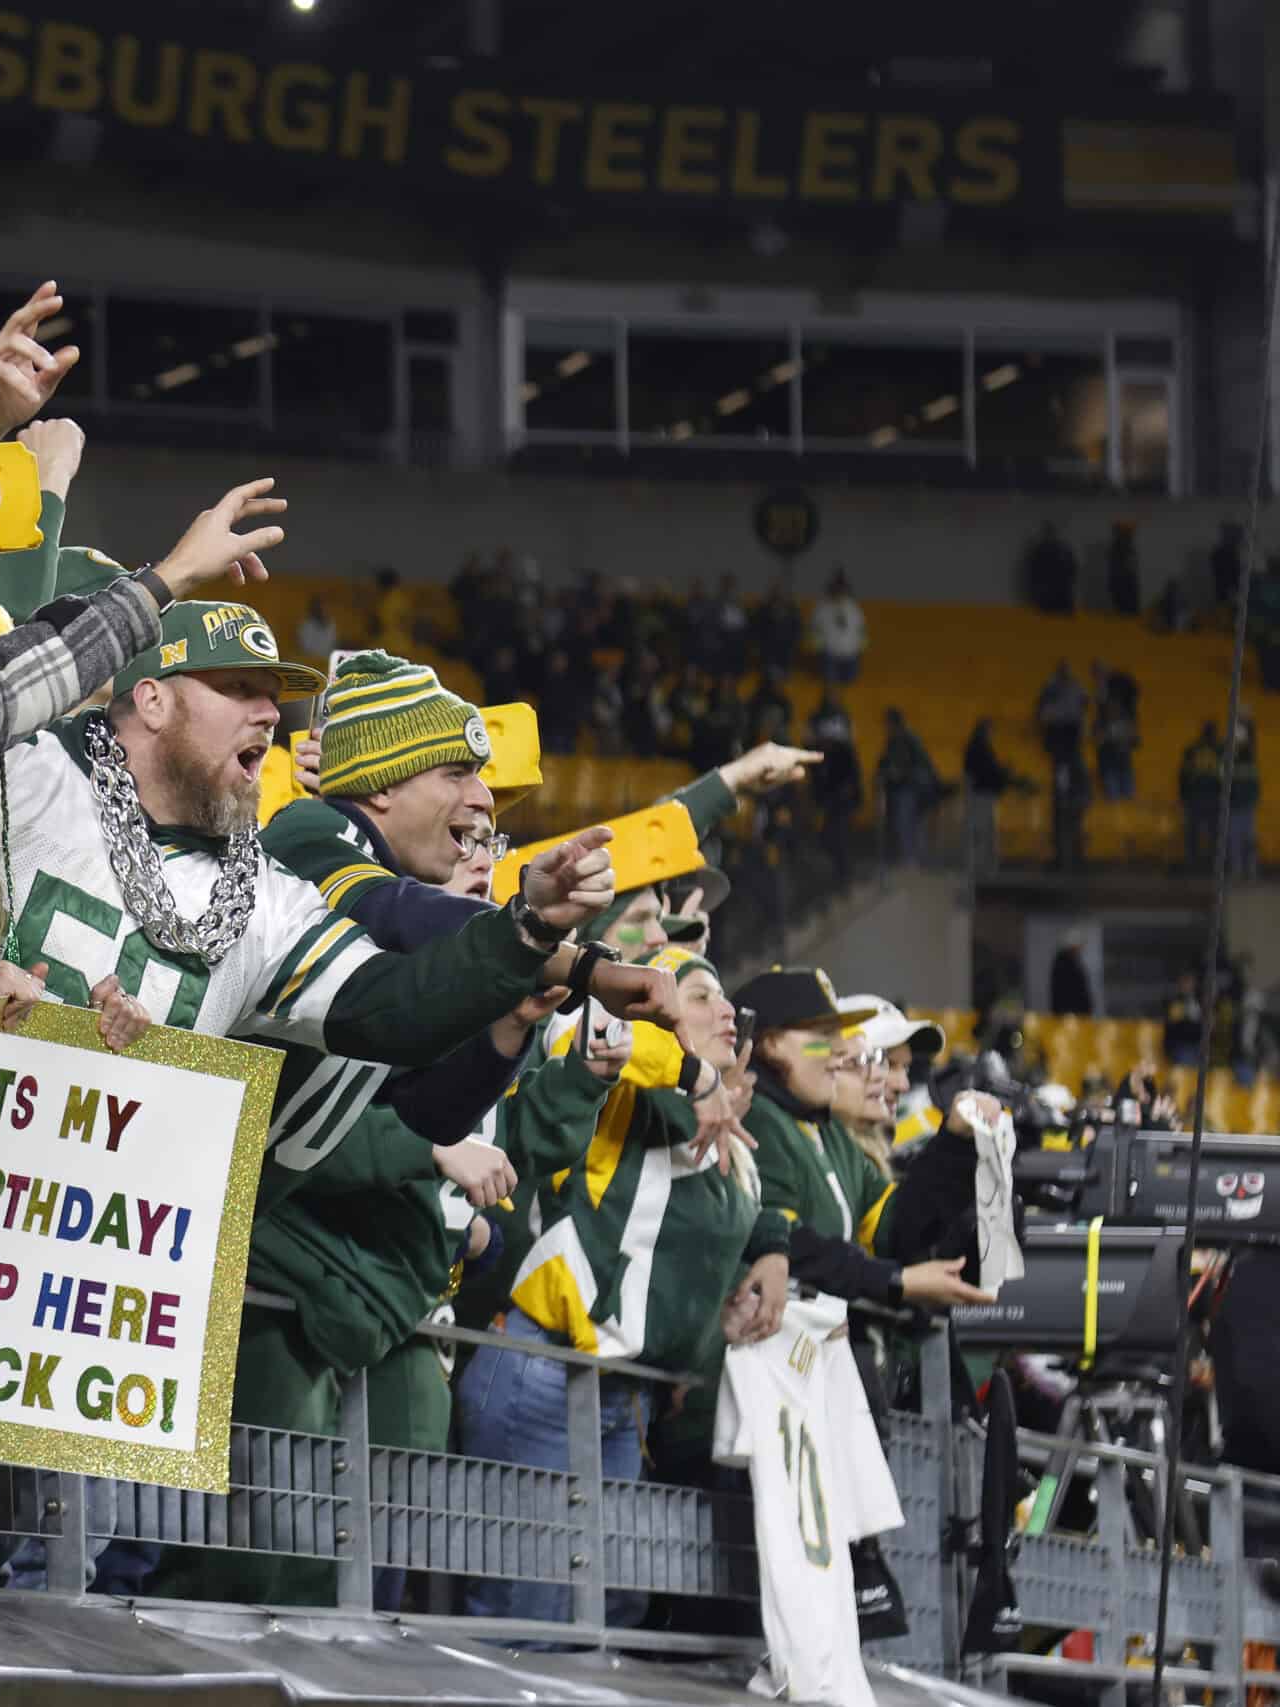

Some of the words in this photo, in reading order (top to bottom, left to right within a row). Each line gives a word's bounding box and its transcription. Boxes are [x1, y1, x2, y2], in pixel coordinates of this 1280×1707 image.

[444, 88, 1021, 204] STEELERS
[160, 639, 188, 668] N
[59, 1085, 142, 1153] MY
[32, 1271, 181, 1349] HERE
[75, 1365, 179, 1434] GO!
